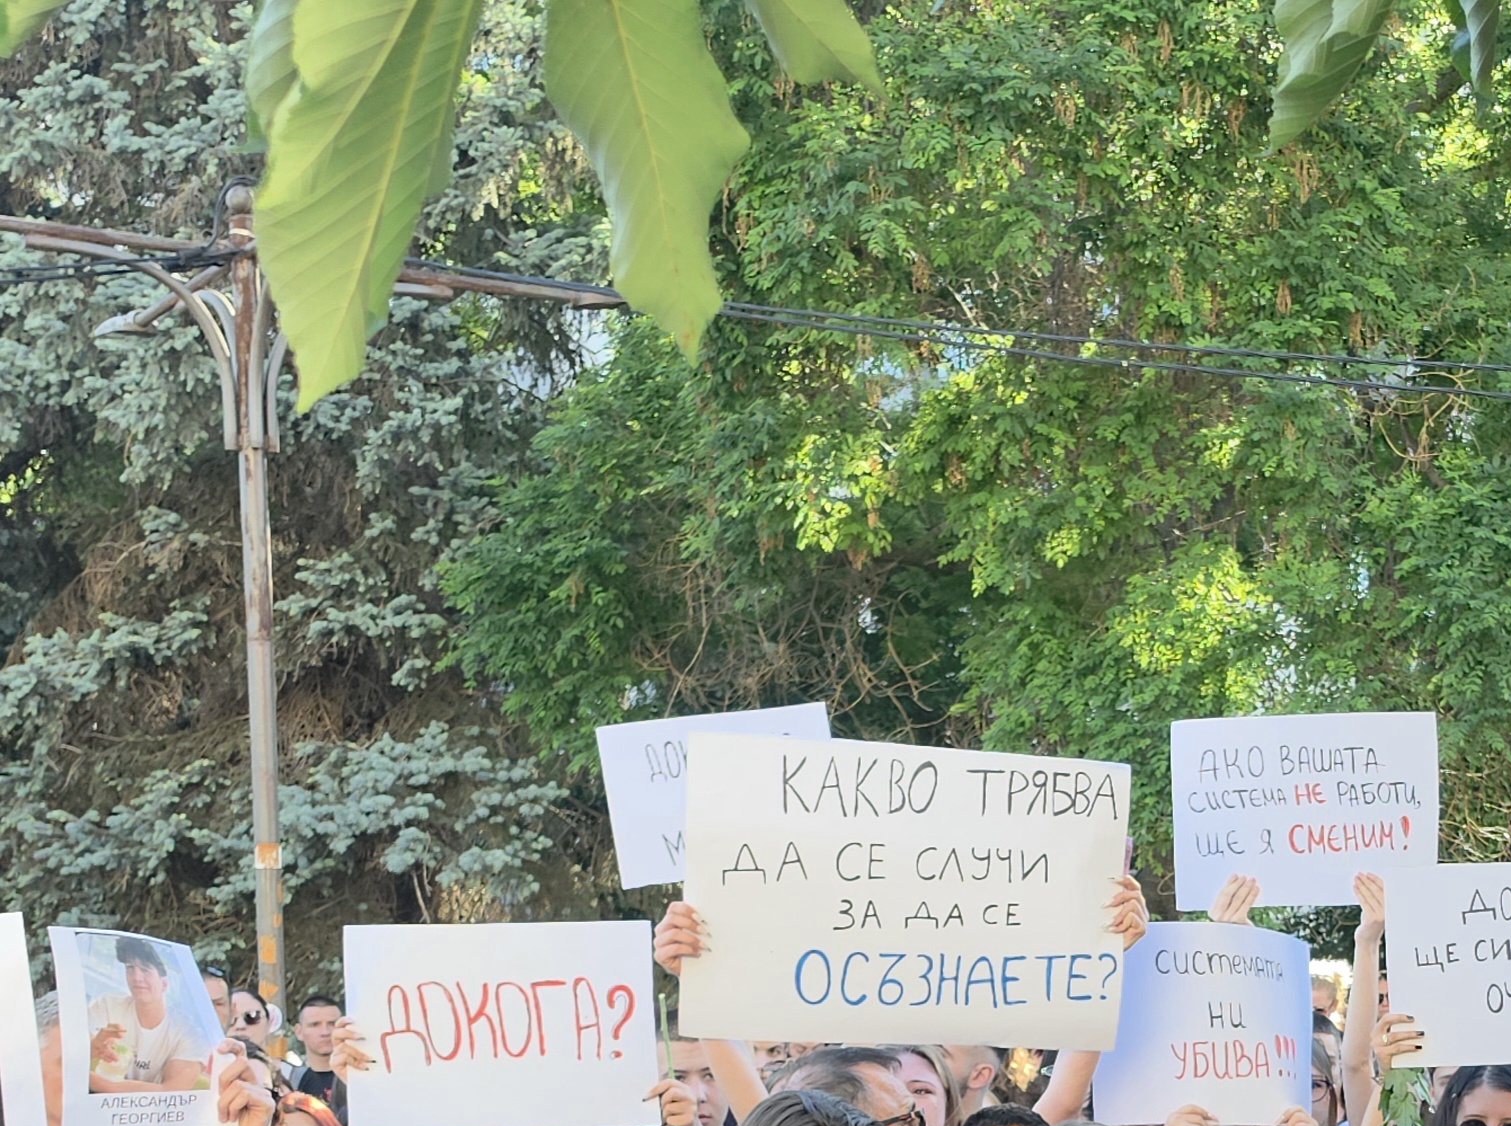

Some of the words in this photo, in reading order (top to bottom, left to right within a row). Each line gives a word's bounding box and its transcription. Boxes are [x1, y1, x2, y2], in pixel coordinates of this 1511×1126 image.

[1198, 746, 1265, 783] АКО
[1280, 745, 1386, 776] ВАШАТА
[782, 754, 938, 818] КАКВО
[968, 768, 1118, 821] ТРЯБВА
[1188, 788, 1287, 813] СИСТЕМА
[1295, 783, 1327, 806] НЕ
[1337, 780, 1422, 810] РАБОТИ,
[1195, 830, 1246, 858] ЩЕ
[1259, 828, 1275, 855] Я
[1288, 815, 1411, 855] СМЕНИМ!
[722, 841, 809, 886] ДА
[835, 841, 887, 882] СЕ
[916, 846, 1049, 884] СЛУЧИ
[832, 899, 882, 931] ЗА
[904, 901, 964, 929] ДА
[982, 902, 1022, 927] СЕ
[1415, 944, 1460, 973] ЩЕ
[794, 948, 1118, 1009] ОСЪЗНАЕТЕ?
[379, 976, 637, 1074] ДОКОГА?
[1208, 1001, 1247, 1030] НИ
[1171, 1034, 1297, 1081] УБИВА!!!
[101, 1094, 198, 1109] АЛЕКСАНДЪР
[112, 1111, 185, 1125] ГЕОРГИЕВ
